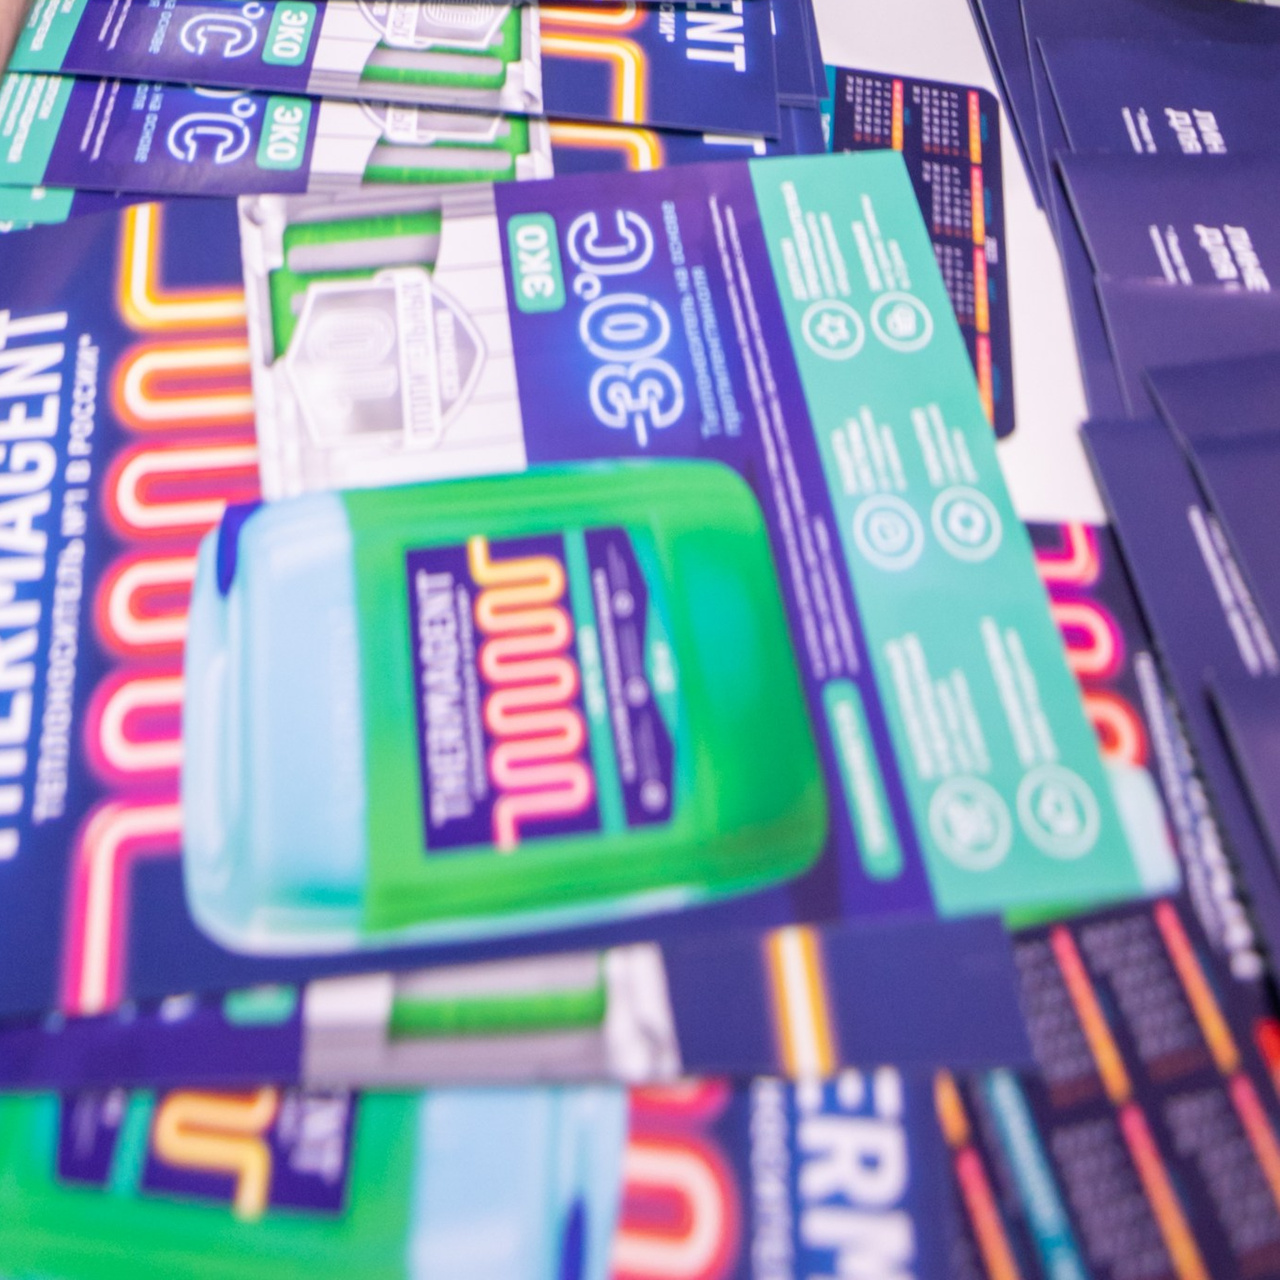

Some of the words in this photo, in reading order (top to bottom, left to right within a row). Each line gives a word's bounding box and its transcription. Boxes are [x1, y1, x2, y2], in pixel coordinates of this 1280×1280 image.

[271, 9, 310, 60] ЭКО
[266, 104, 304, 162] ЭКО
[515, 223, 557, 301] ЭКО
[566, 209, 687, 449] -30°C
